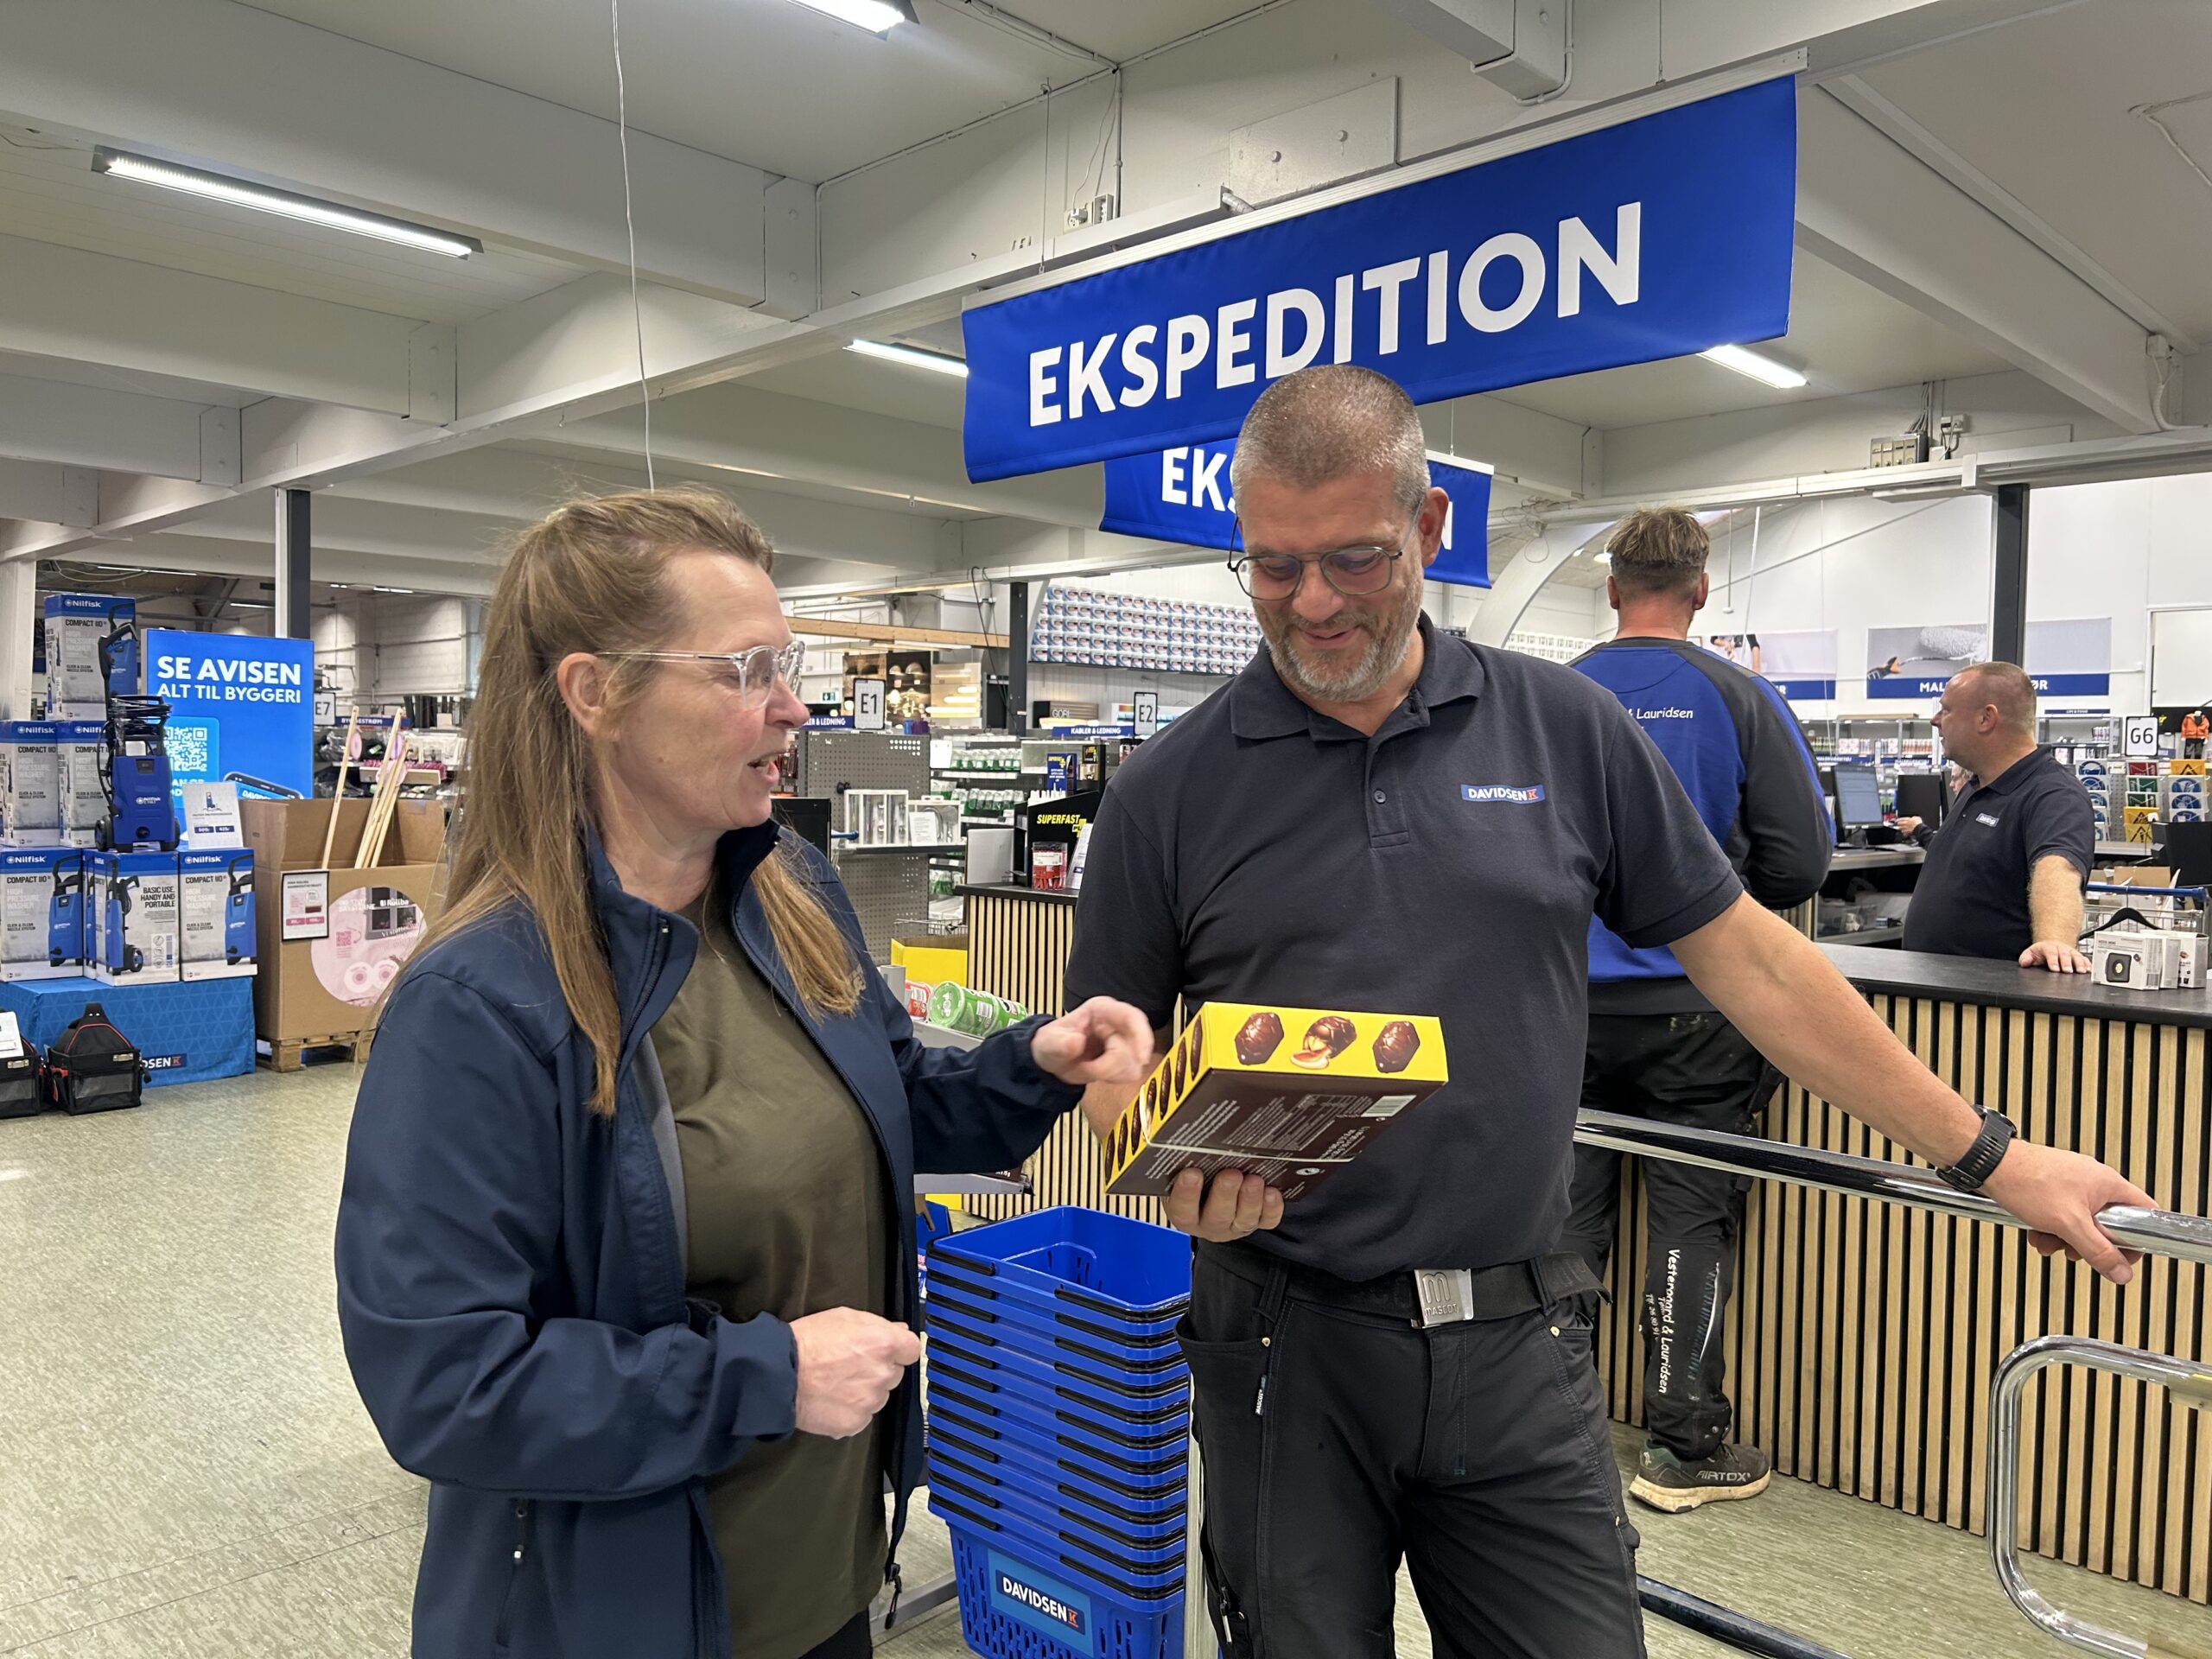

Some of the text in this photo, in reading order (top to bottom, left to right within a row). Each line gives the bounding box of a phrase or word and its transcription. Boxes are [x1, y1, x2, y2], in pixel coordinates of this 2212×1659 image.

[1029, 201, 1641, 427] EKSPEDITION
[72, 600, 102, 608] Nilfisk
[156, 655, 302, 685] SE AVISEN
[156, 683, 302, 703] ALT TIL BYGGERI
[315, 702, 331, 716] E7
[860, 693, 877, 715] E1
[1138, 704, 1154, 723] E2
[1636, 706, 1694, 720] Lauridsen
[2130, 728, 2154, 745] G6
[1468, 787, 1528, 801] DAVIDSEN
[1037, 814, 1080, 825] SUPERFAST
[185, 875, 213, 884] COMPACT
[1424, 1304, 1459, 1317] MASCOT
[1662, 1325, 1675, 1335] &
[1658, 1337, 1673, 1394] Lauridsen
[1695, 1470, 1747, 1483] AIRTOX
[1002, 1576, 1068, 1623] DAVIDSEN
